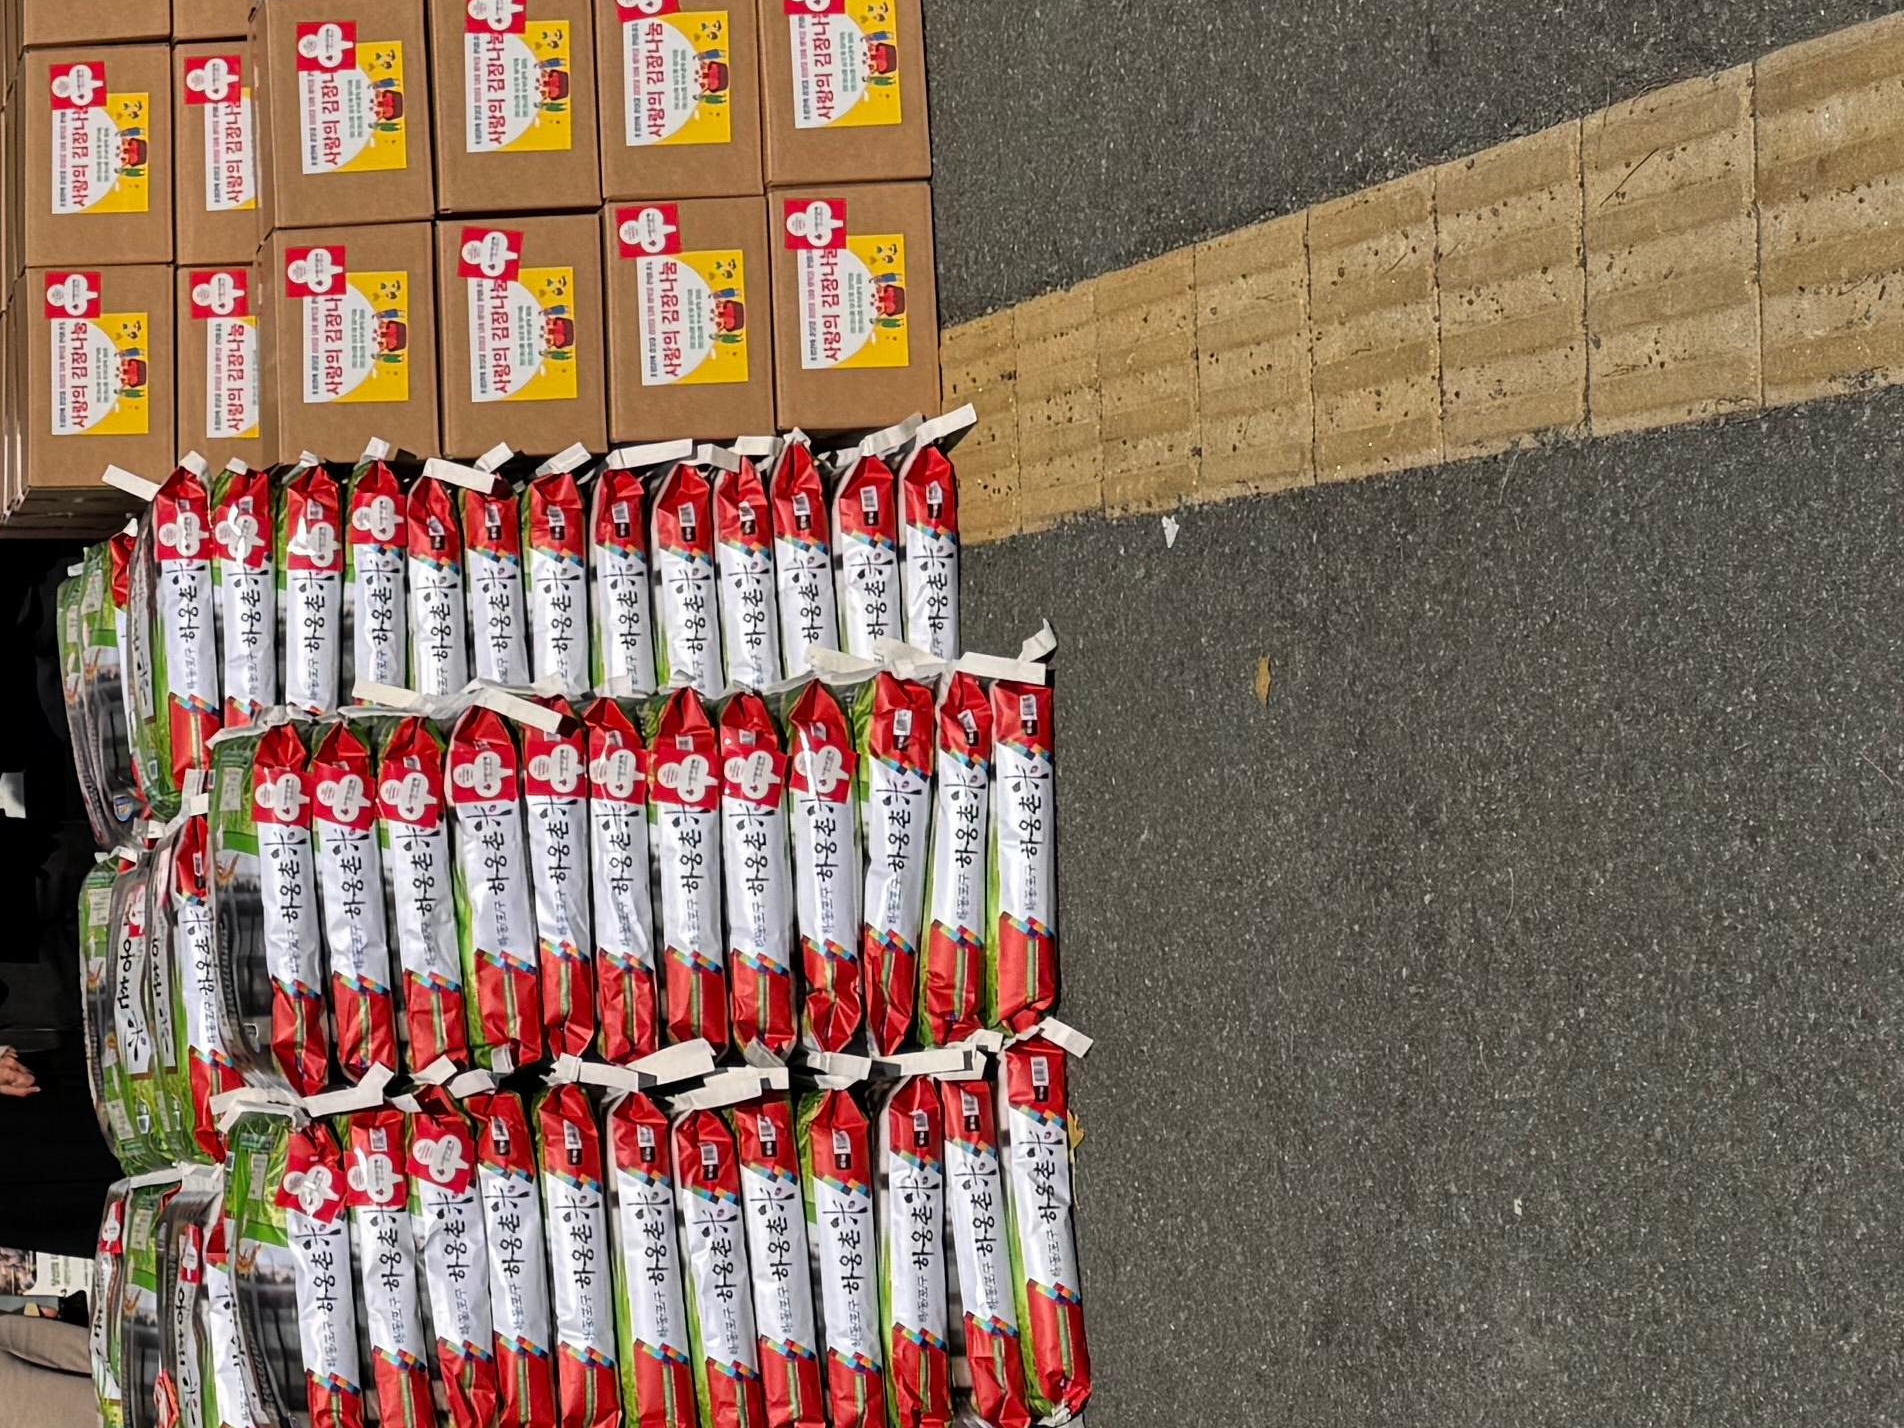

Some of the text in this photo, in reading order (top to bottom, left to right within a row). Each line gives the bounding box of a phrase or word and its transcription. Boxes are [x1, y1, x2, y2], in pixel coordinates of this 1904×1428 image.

[647, 23, 664, 137] 사랑의 김장나눔
[816, 76, 833, 119] 사랑의
[322, 120, 339, 165] 사랑의
[489, 99, 505, 144] 사랑의
[72, 165, 88, 207] 사랑의
[226, 161, 242, 203] 사랑의
[661, 262, 681, 377] 사랑의 김장나눔
[823, 315, 841, 360] 사랑의
[227, 324, 244, 431] 사랑의 김장나눔
[326, 350, 342, 395] 사랑의
[492, 348, 510, 393] 사랑의
[72, 386, 88, 428] 사랑의
[178, 585, 199, 642] 하옹촌
[241, 589, 262, 647] 하옹촌
[304, 595, 325, 653] 하옹촌
[372, 587, 393, 645] 하옹촌
[430, 603, 453, 662] 하옹촌
[489, 594, 512, 652] 하옹촌
[552, 594, 573, 654] 하옹촌
[617, 591, 641, 650] 하옹촌
[683, 595, 707, 654] 하옹촌
[742, 589, 766, 649] 하옹촌
[799, 583, 823, 644] 하옹촌
[864, 581, 888, 640] 하옹촌
[927, 573, 949, 634] 하옹촌
[547, 821, 571, 884] 하옹촌
[814, 818, 838, 882] 하옹촌
[888, 809, 910, 872] 하옹촌
[955, 804, 979, 868] 하옹촌
[1019, 794, 1045, 859] 하옹촌
[278, 860, 303, 923] 하옹촌
[340, 856, 365, 919] 하옹촌
[411, 853, 437, 918] 하옹촌
[482, 831, 509, 895] 하옹촌
[610, 832, 633, 895] 하옹촌
[679, 829, 704, 893] 하옹촌
[744, 832, 769, 896] 하옹촌
[1034, 1160, 1060, 1224] 하옹촌
[443, 1220, 469, 1282] 하옹촌
[498, 1213, 524, 1278] 하옹촌
[643, 1220, 669, 1286] 하옹촌
[766, 1216, 792, 1281] 하옹촌
[911, 1205, 934, 1270] 하옹촌
[971, 1192, 997, 1257] 하옹촌
[311, 1251, 337, 1312] 하옹촌
[378, 1228, 403, 1292] 하옹촌
[570, 1224, 596, 1289] 하옹촌
[711, 1238, 736, 1302] 하옹촌
[838, 1230, 864, 1294] 하옹촌
